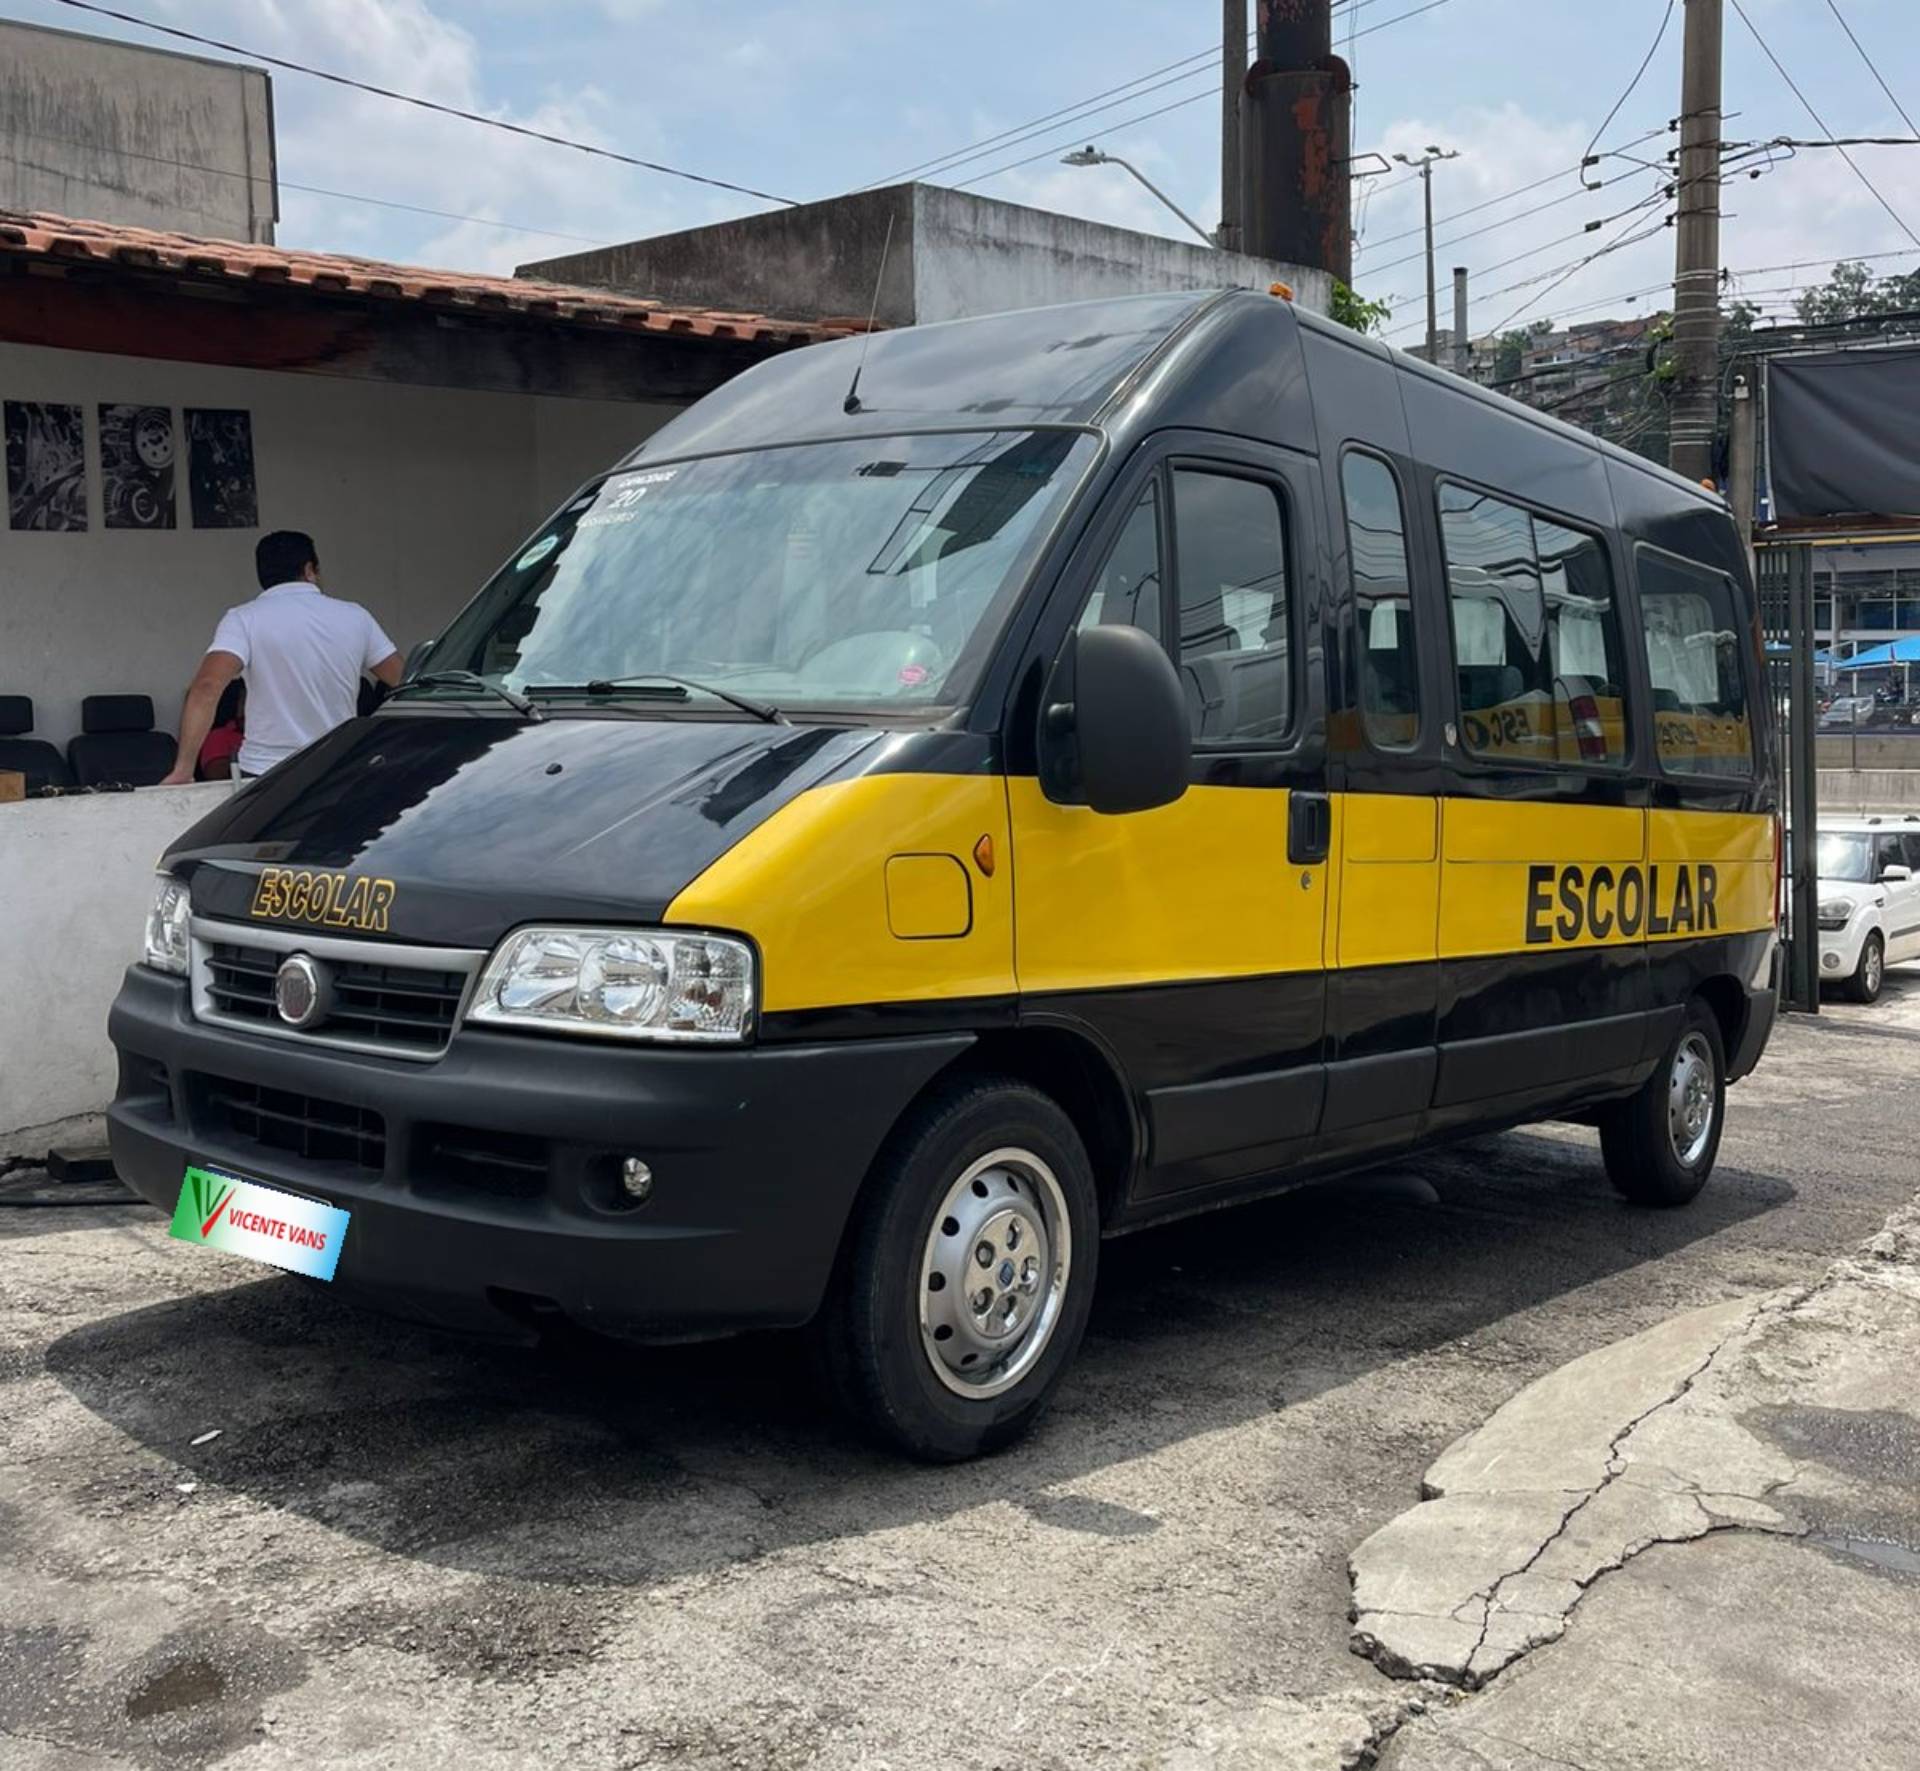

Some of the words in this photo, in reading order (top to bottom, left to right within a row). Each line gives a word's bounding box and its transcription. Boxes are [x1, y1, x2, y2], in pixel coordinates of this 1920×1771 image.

[607, 487, 647, 509] 20
[252, 868, 395, 932] ESCOLAR
[1526, 864, 1718, 944] ESCOLAR
